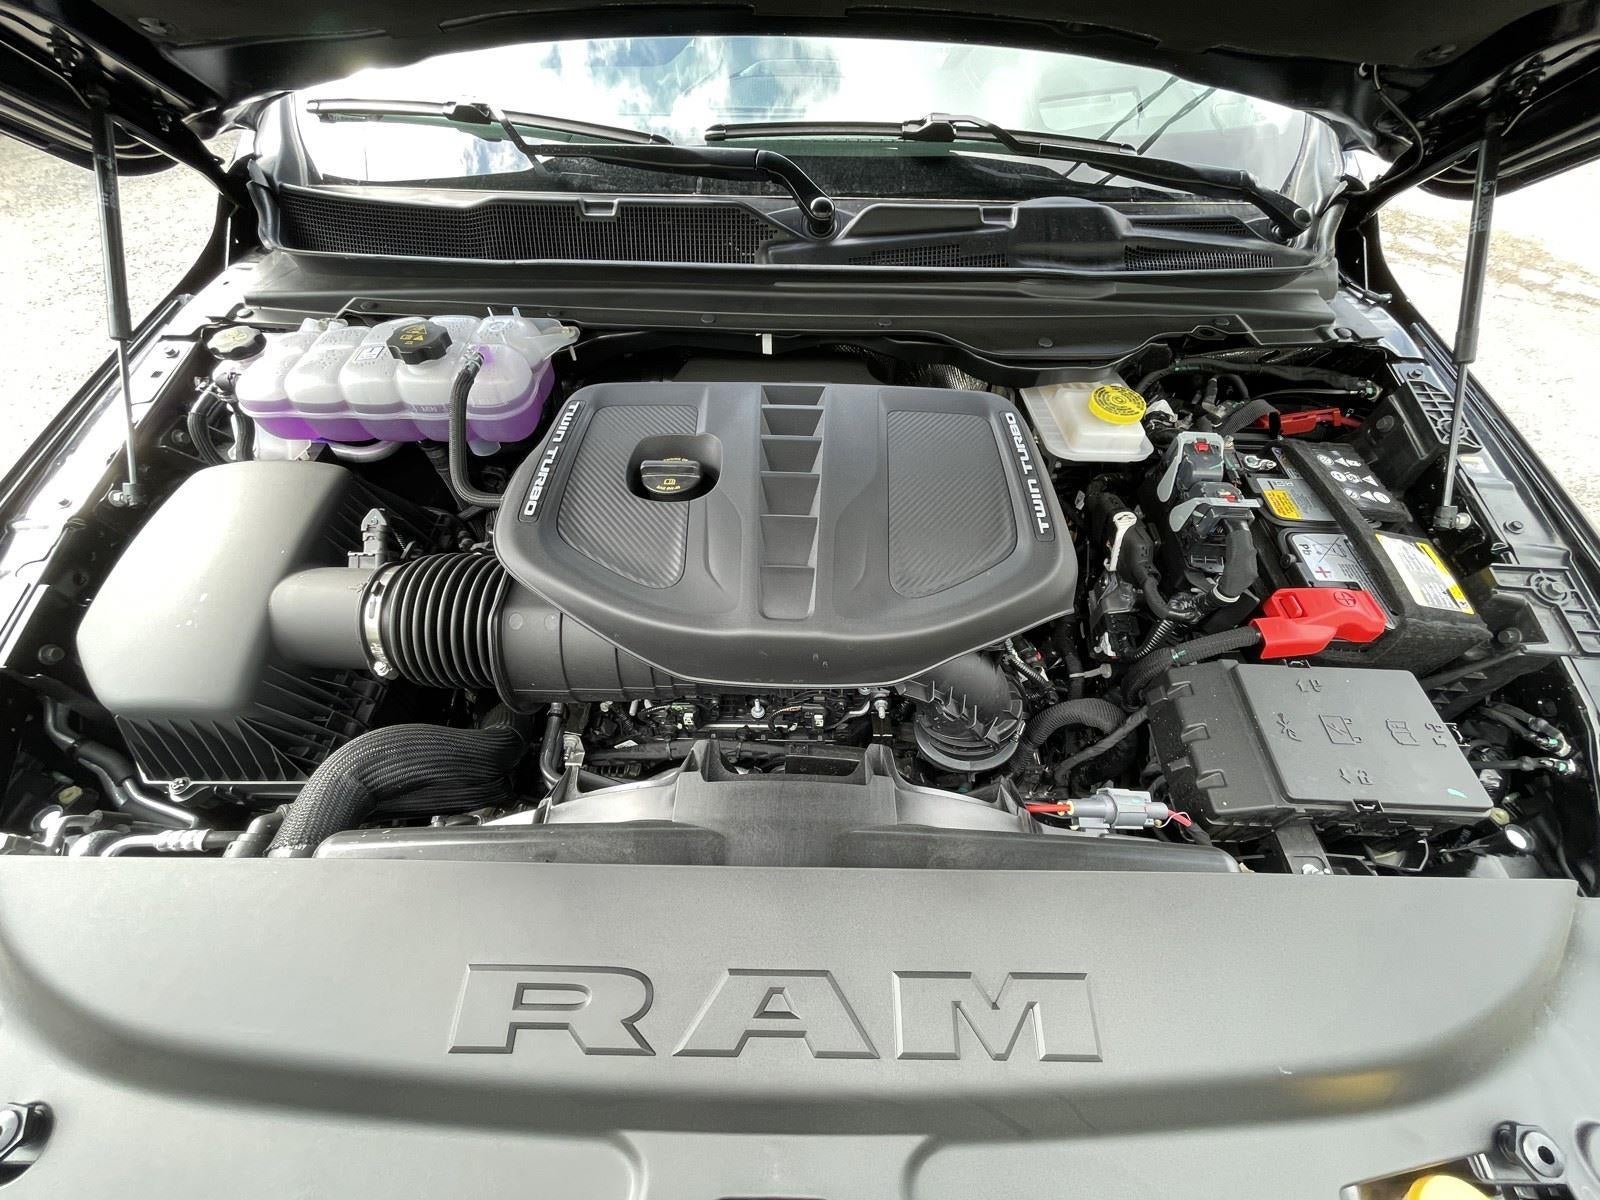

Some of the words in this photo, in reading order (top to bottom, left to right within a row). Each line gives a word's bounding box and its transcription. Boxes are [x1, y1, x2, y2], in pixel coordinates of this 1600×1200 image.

[552, 401, 580, 443] TWIN
[1005, 412, 1033, 475] TURBO
[523, 446, 559, 516] TURBO
[1027, 478, 1050, 534] TWIN
[448, 963, 1103, 1063] RAM
